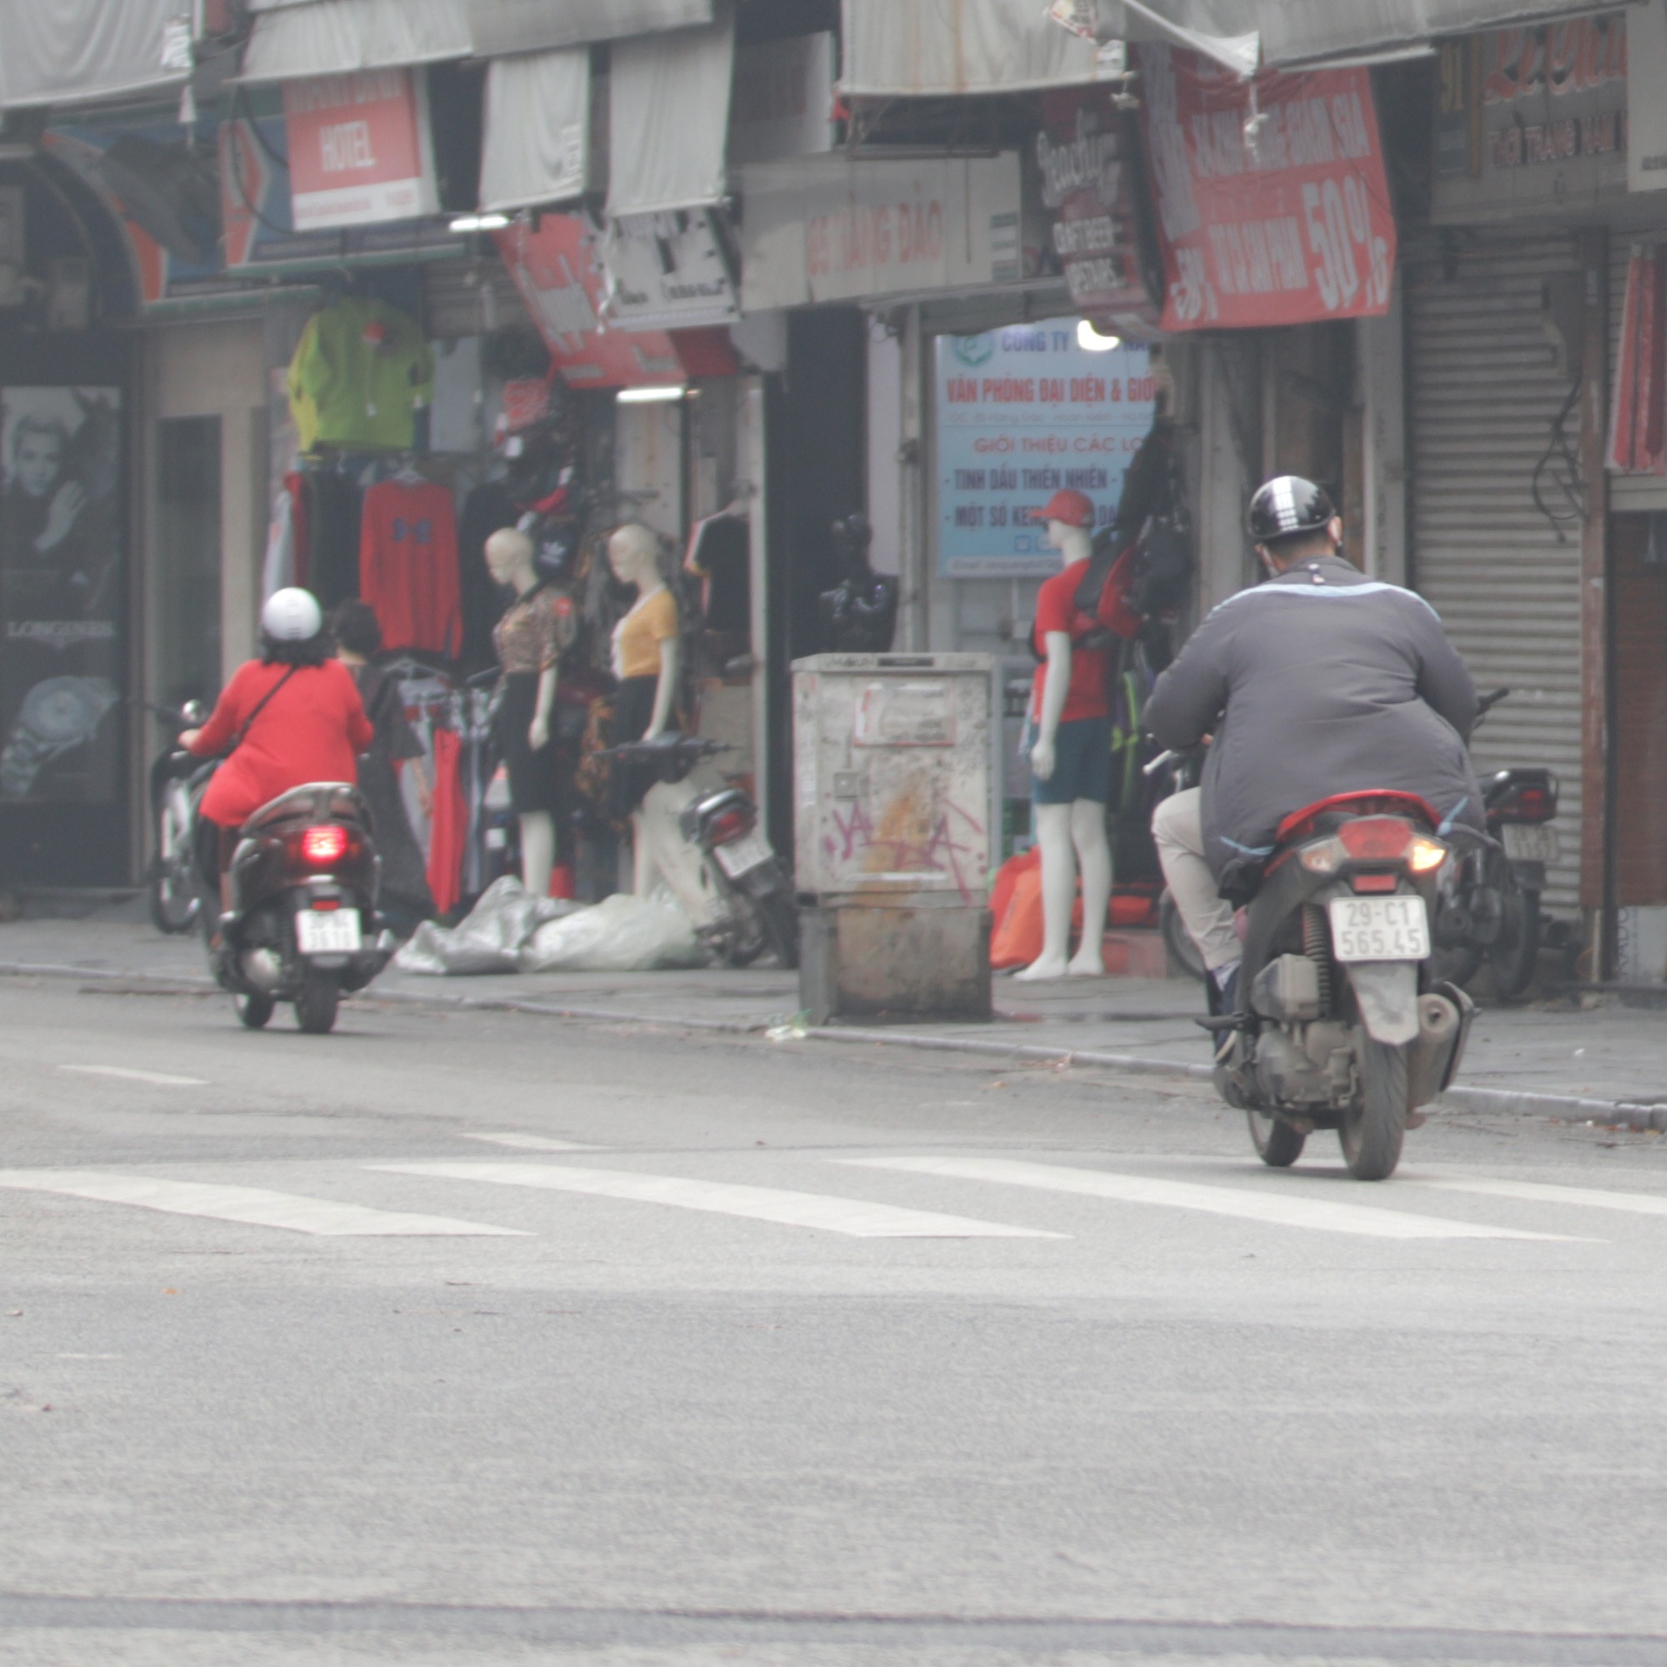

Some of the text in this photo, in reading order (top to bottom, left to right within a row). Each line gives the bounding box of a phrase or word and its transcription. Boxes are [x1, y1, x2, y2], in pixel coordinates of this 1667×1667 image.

[1440, 42, 1464, 111] 91
[320, 120, 375, 172] HOTEL
[1525, 119, 1576, 164] TRANG
[1303, 172, 1388, 311] 50%
[1052, 331, 1071, 353] TY
[982, 371, 1034, 403] PHÒNG
[1070, 372, 1105, 408] DIỆN
[1111, 379, 1121, 402] &
[974, 435, 1015, 454] GIỚI
[1074, 434, 1115, 453] CÁC
[954, 468, 985, 491] TINH
[1022, 464, 1060, 491] THIÊN
[1065, 464, 1107, 490] NHIÊN
[954, 496, 1007, 531] MỘT SỐ
[1346, 901, 1411, 928] 29-C1
[1341, 930, 1422, 956] 565.45
